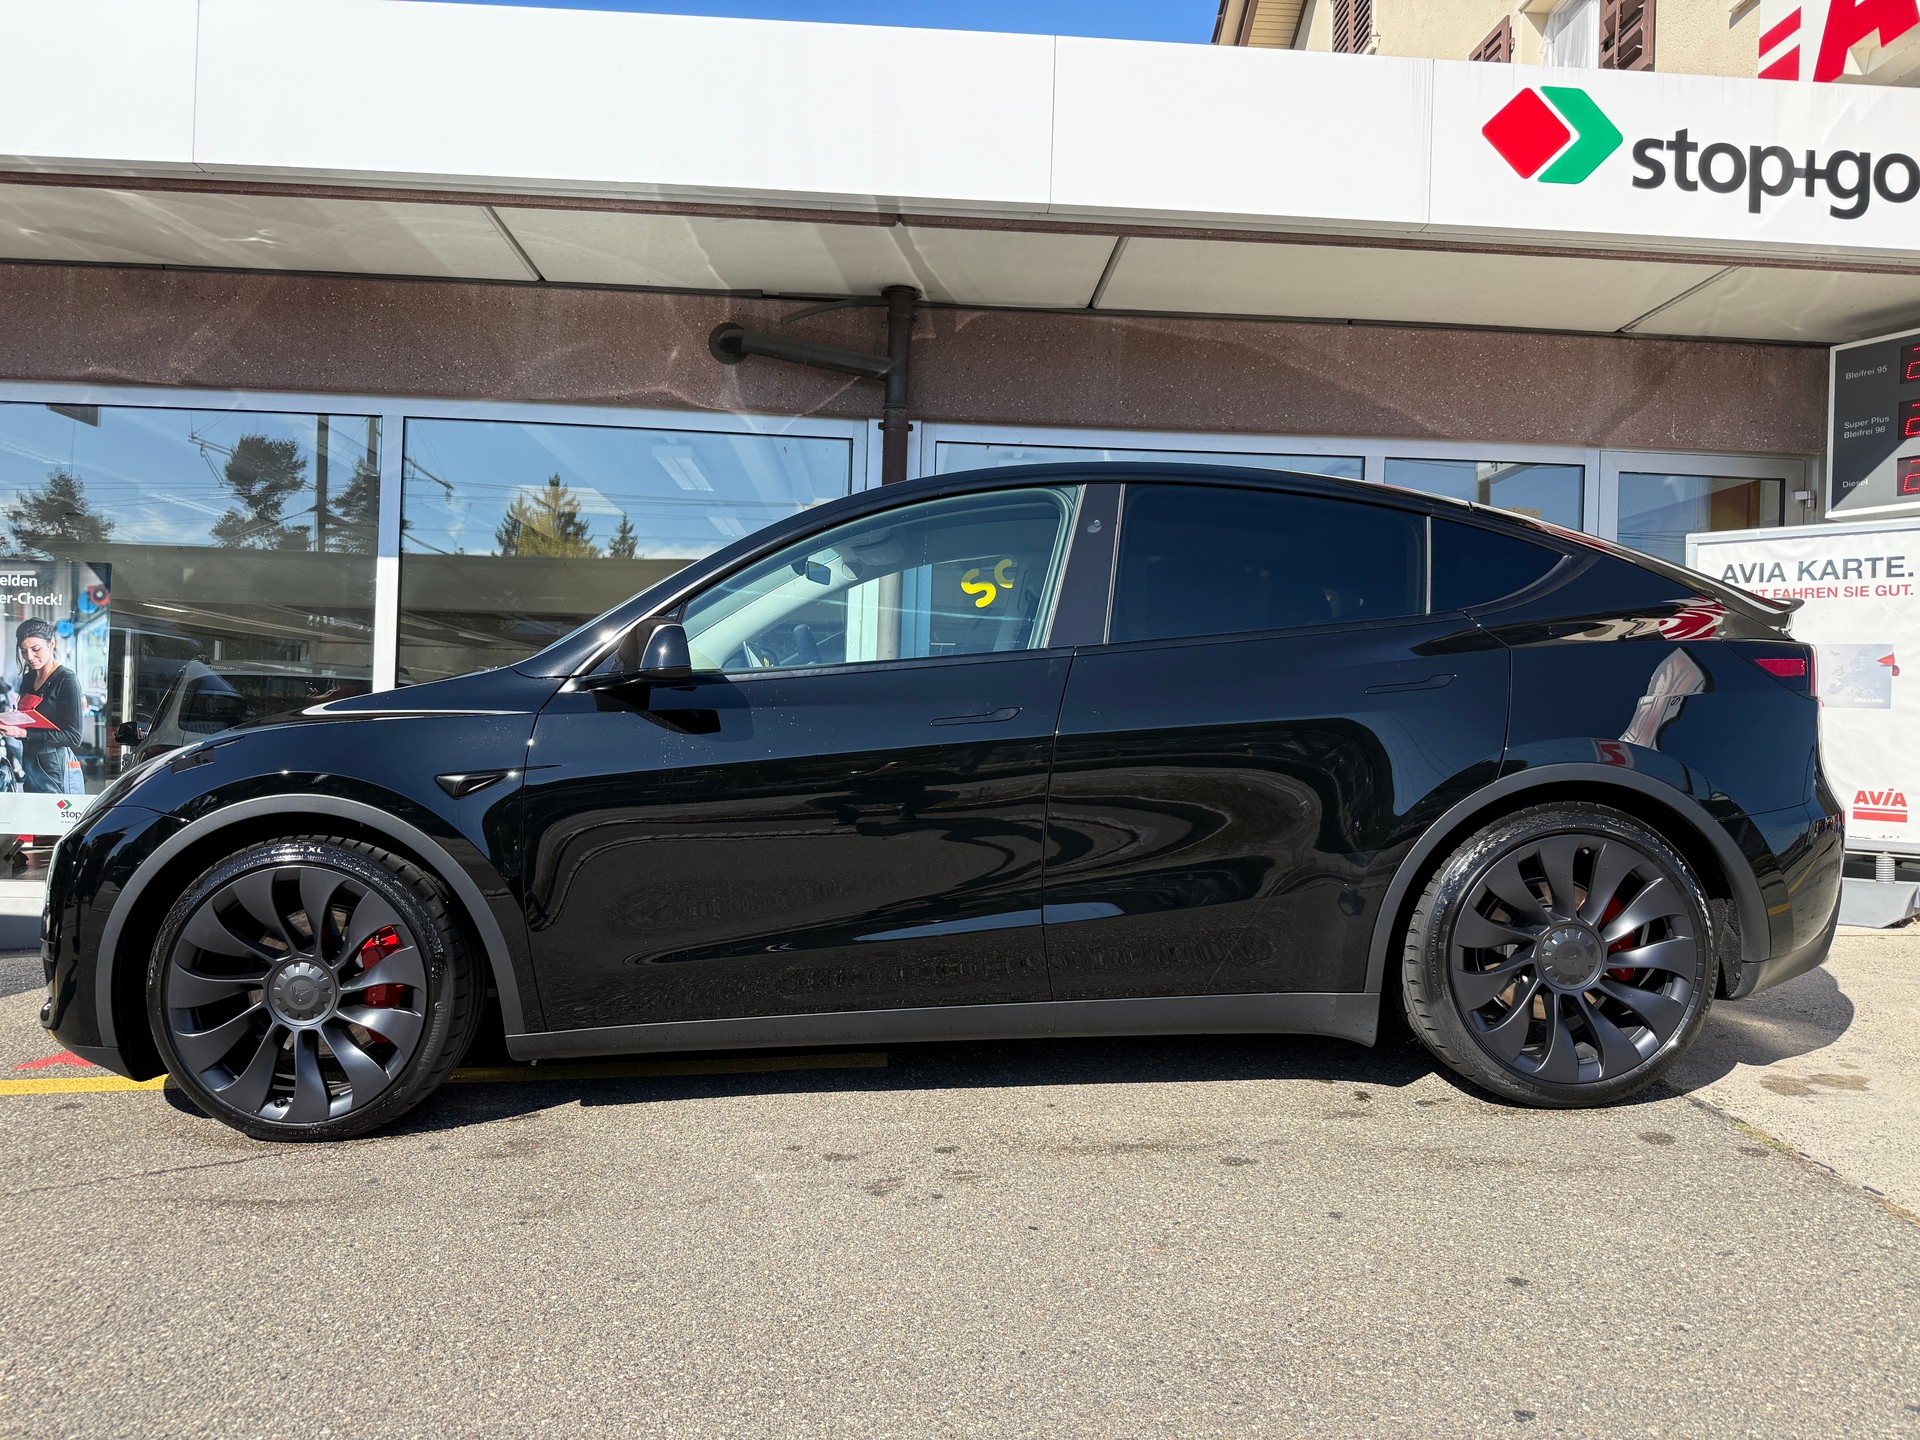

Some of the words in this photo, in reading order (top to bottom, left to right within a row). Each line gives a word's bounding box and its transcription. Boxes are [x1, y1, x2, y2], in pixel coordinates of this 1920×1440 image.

[1632, 128, 1920, 220] stop+go
[1845, 368, 1875, 380] Bleifrei
[1876, 365, 1888, 374] 95
[1844, 420, 1869, 430] Super
[1871, 416, 1890, 425] Plus
[1843, 428, 1873, 439] Bleifrei
[1875, 426, 1886, 434] 98
[1842, 478, 1869, 488] Diesel
[1722, 562, 1787, 584] AVIA
[1797, 556, 1914, 581] KARTE.
[1773, 586, 1838, 599] FAHREN
[1844, 586, 1870, 598] SIE
[1875, 584, 1914, 597] GUT.
